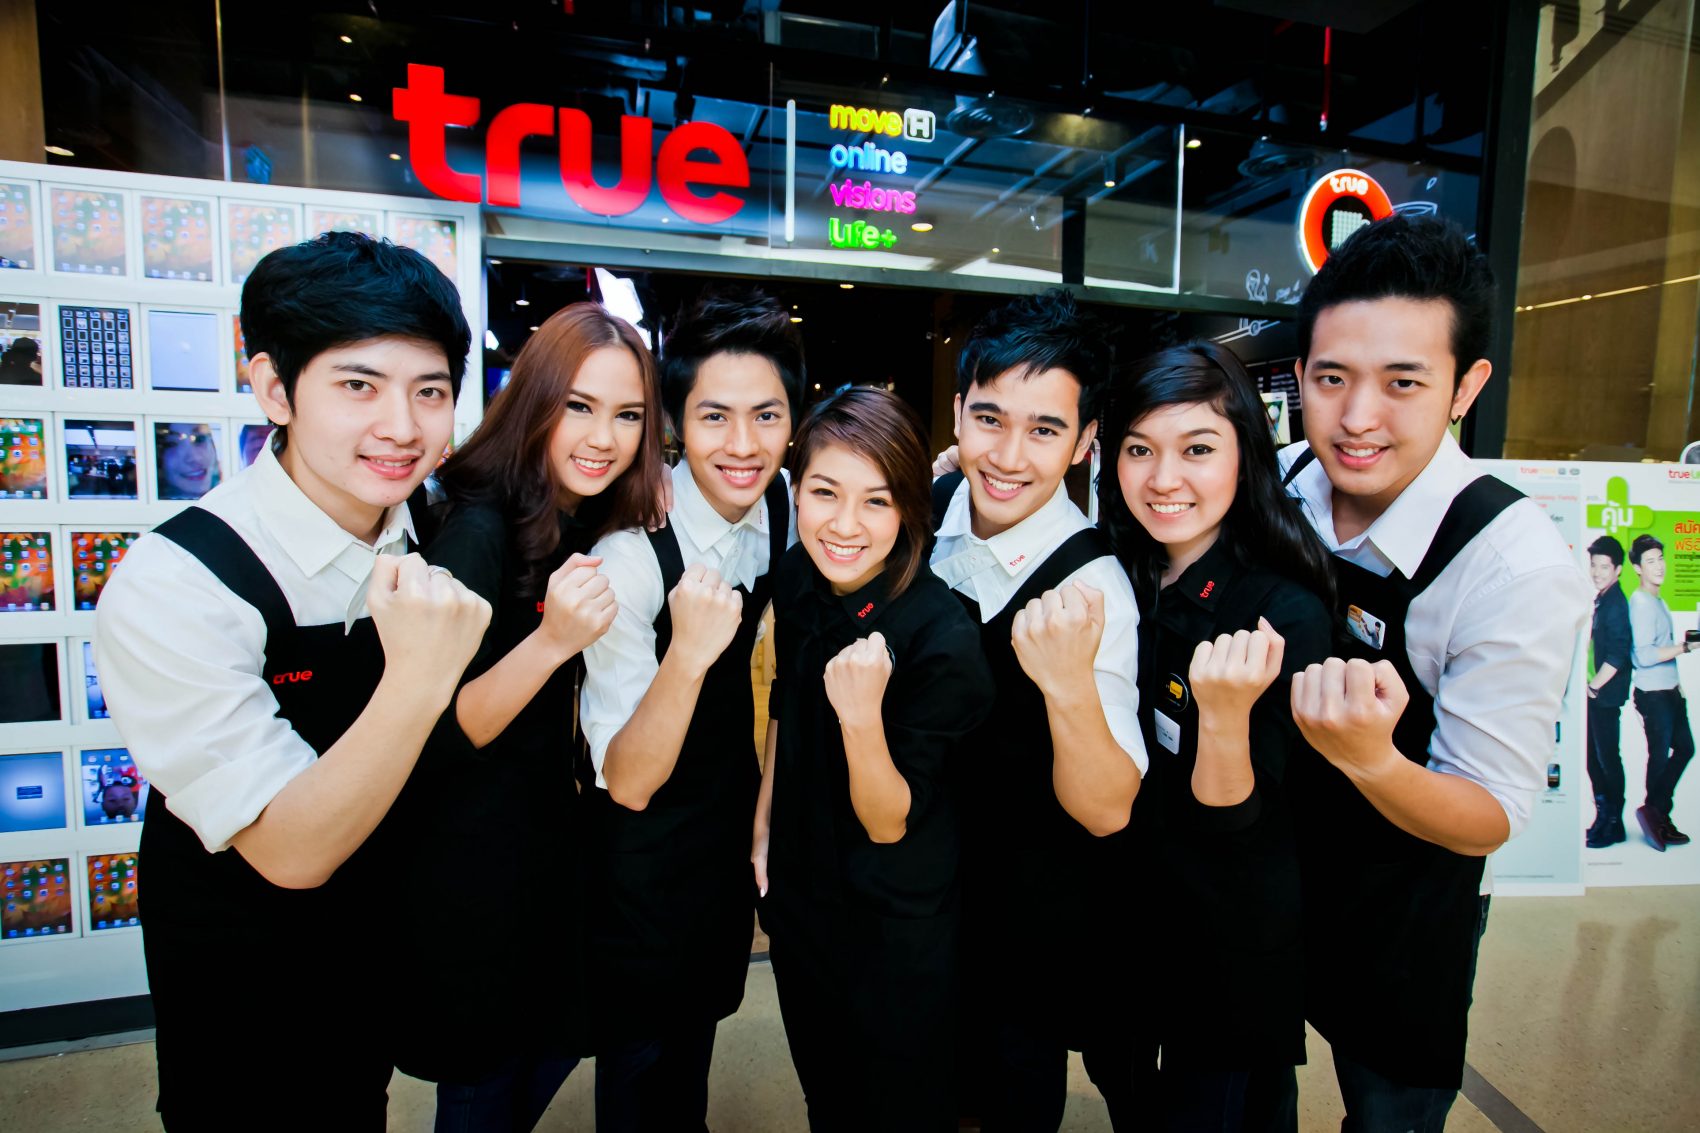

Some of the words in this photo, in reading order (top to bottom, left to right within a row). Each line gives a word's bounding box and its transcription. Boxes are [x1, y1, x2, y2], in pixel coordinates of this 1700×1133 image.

[392, 62, 750, 224] true
[829, 141, 908, 174] online
[1329, 175, 1369, 196] true
[829, 178, 917, 214] visions
[1009, 553, 1026, 567] true
[1200, 580, 1215, 599] true
[857, 602, 874, 619] true
[273, 670, 313, 685] true
